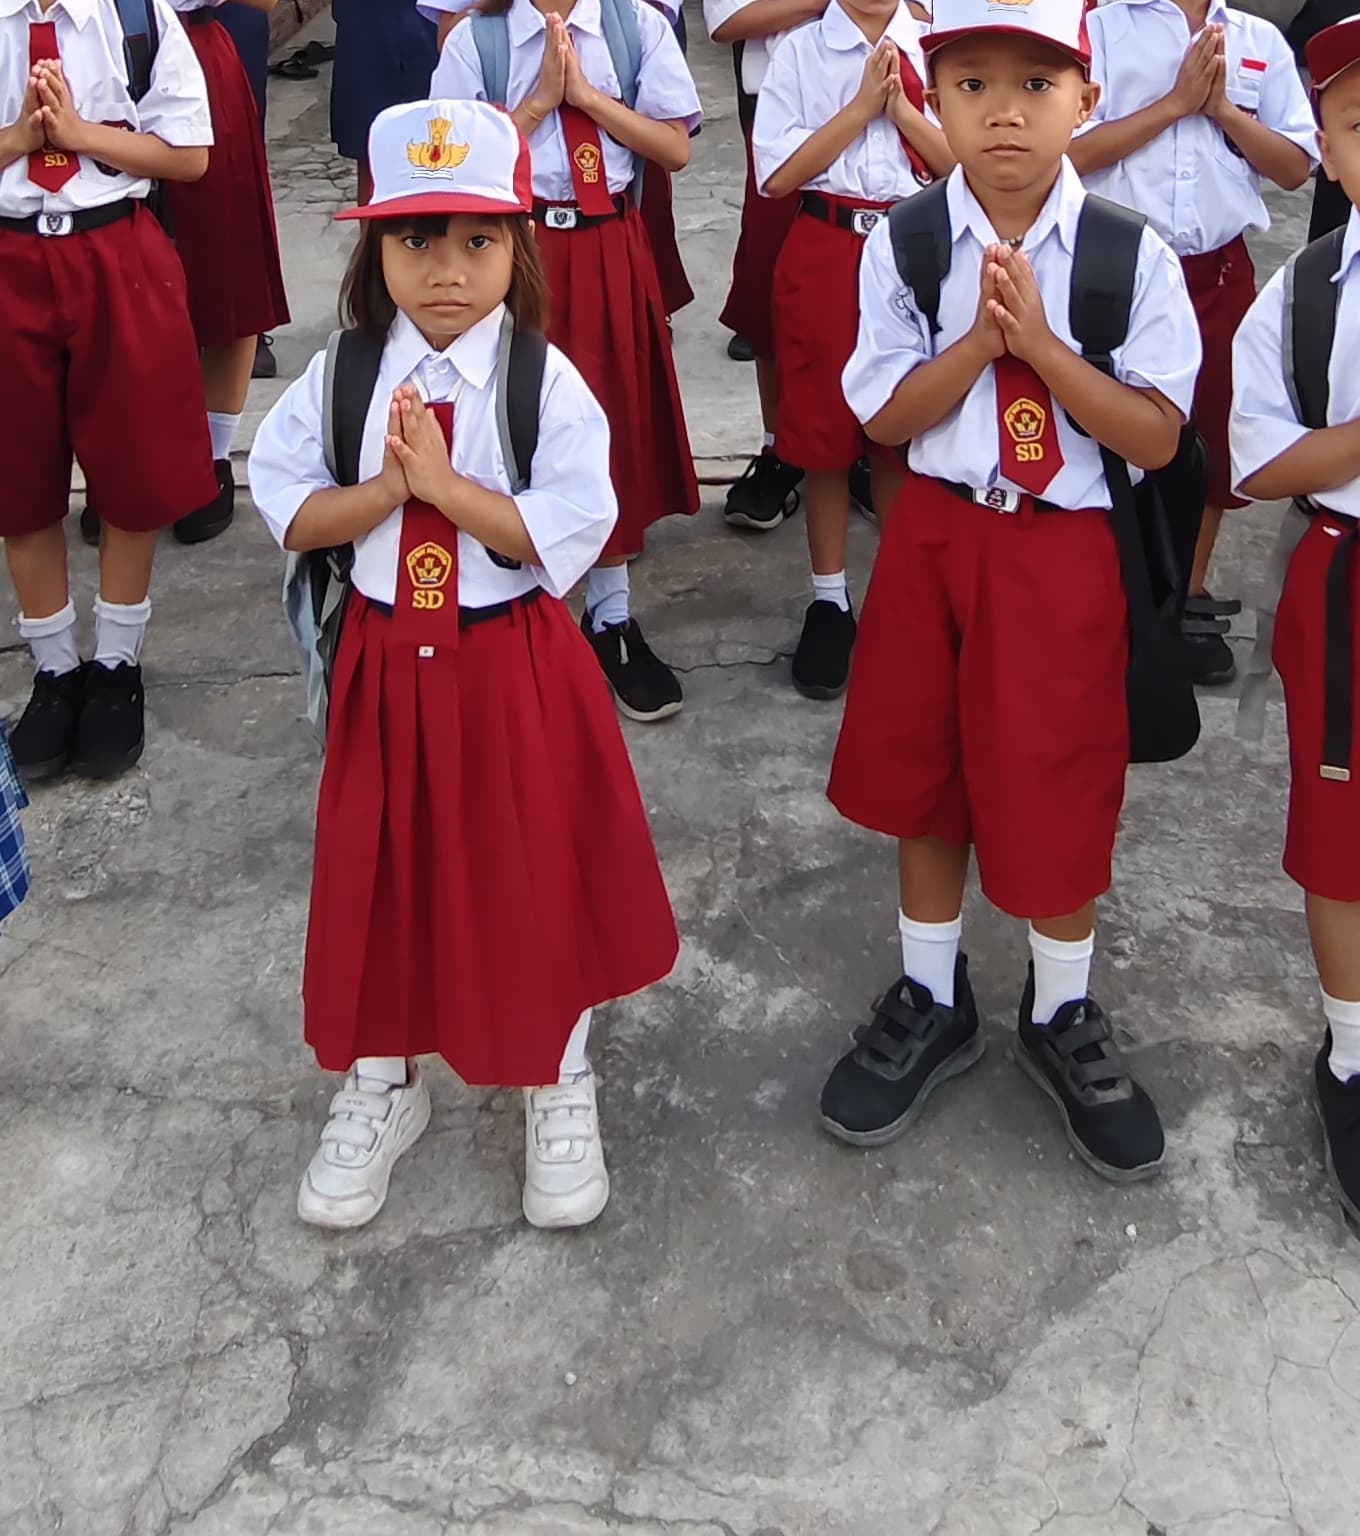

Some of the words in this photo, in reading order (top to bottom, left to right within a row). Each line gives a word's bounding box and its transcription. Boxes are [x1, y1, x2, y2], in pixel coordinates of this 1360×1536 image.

[44, 153, 68, 167] SD
[1015, 443, 1043, 462] SD
[412, 589, 444, 609] SD
